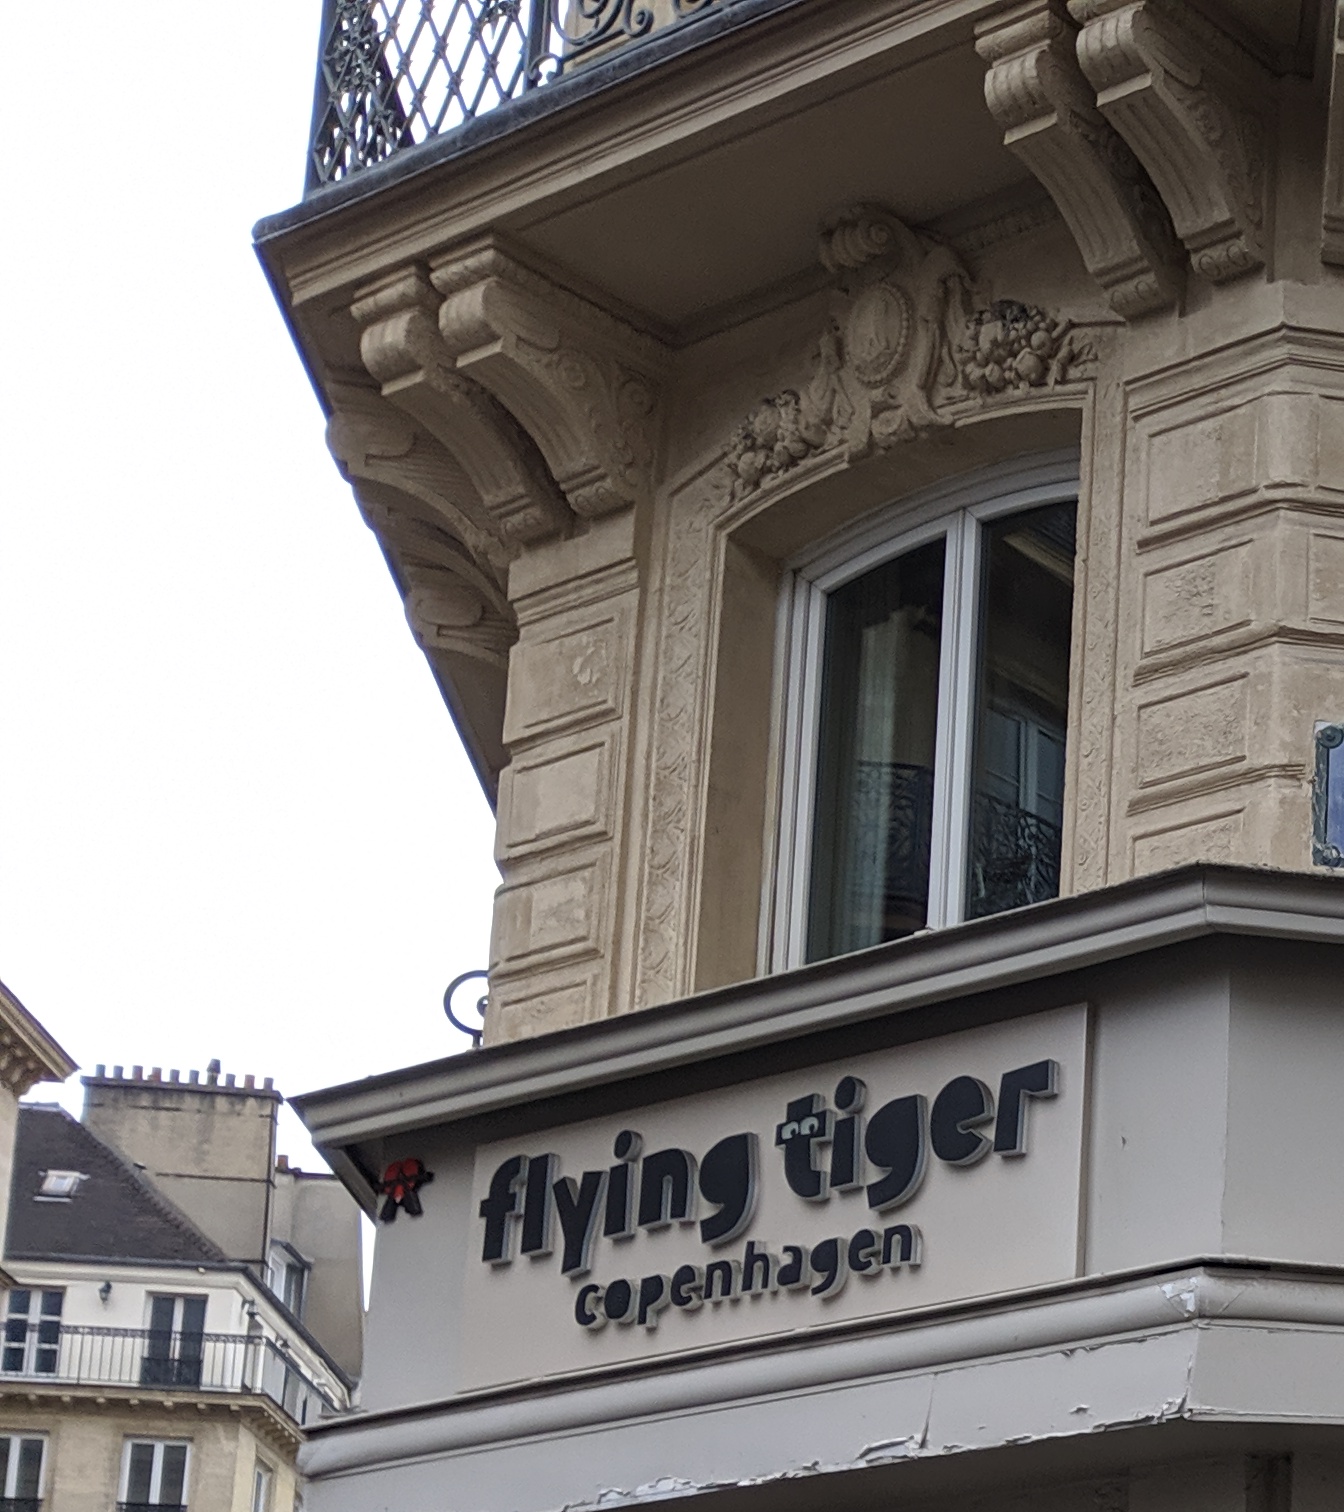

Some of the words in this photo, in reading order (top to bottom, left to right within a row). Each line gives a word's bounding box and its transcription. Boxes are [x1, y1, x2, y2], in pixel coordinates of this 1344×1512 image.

[479, 1130, 760, 1277] flying
[775, 1058, 1059, 1211] tiger
[574, 1220, 923, 1330] copenhagen
